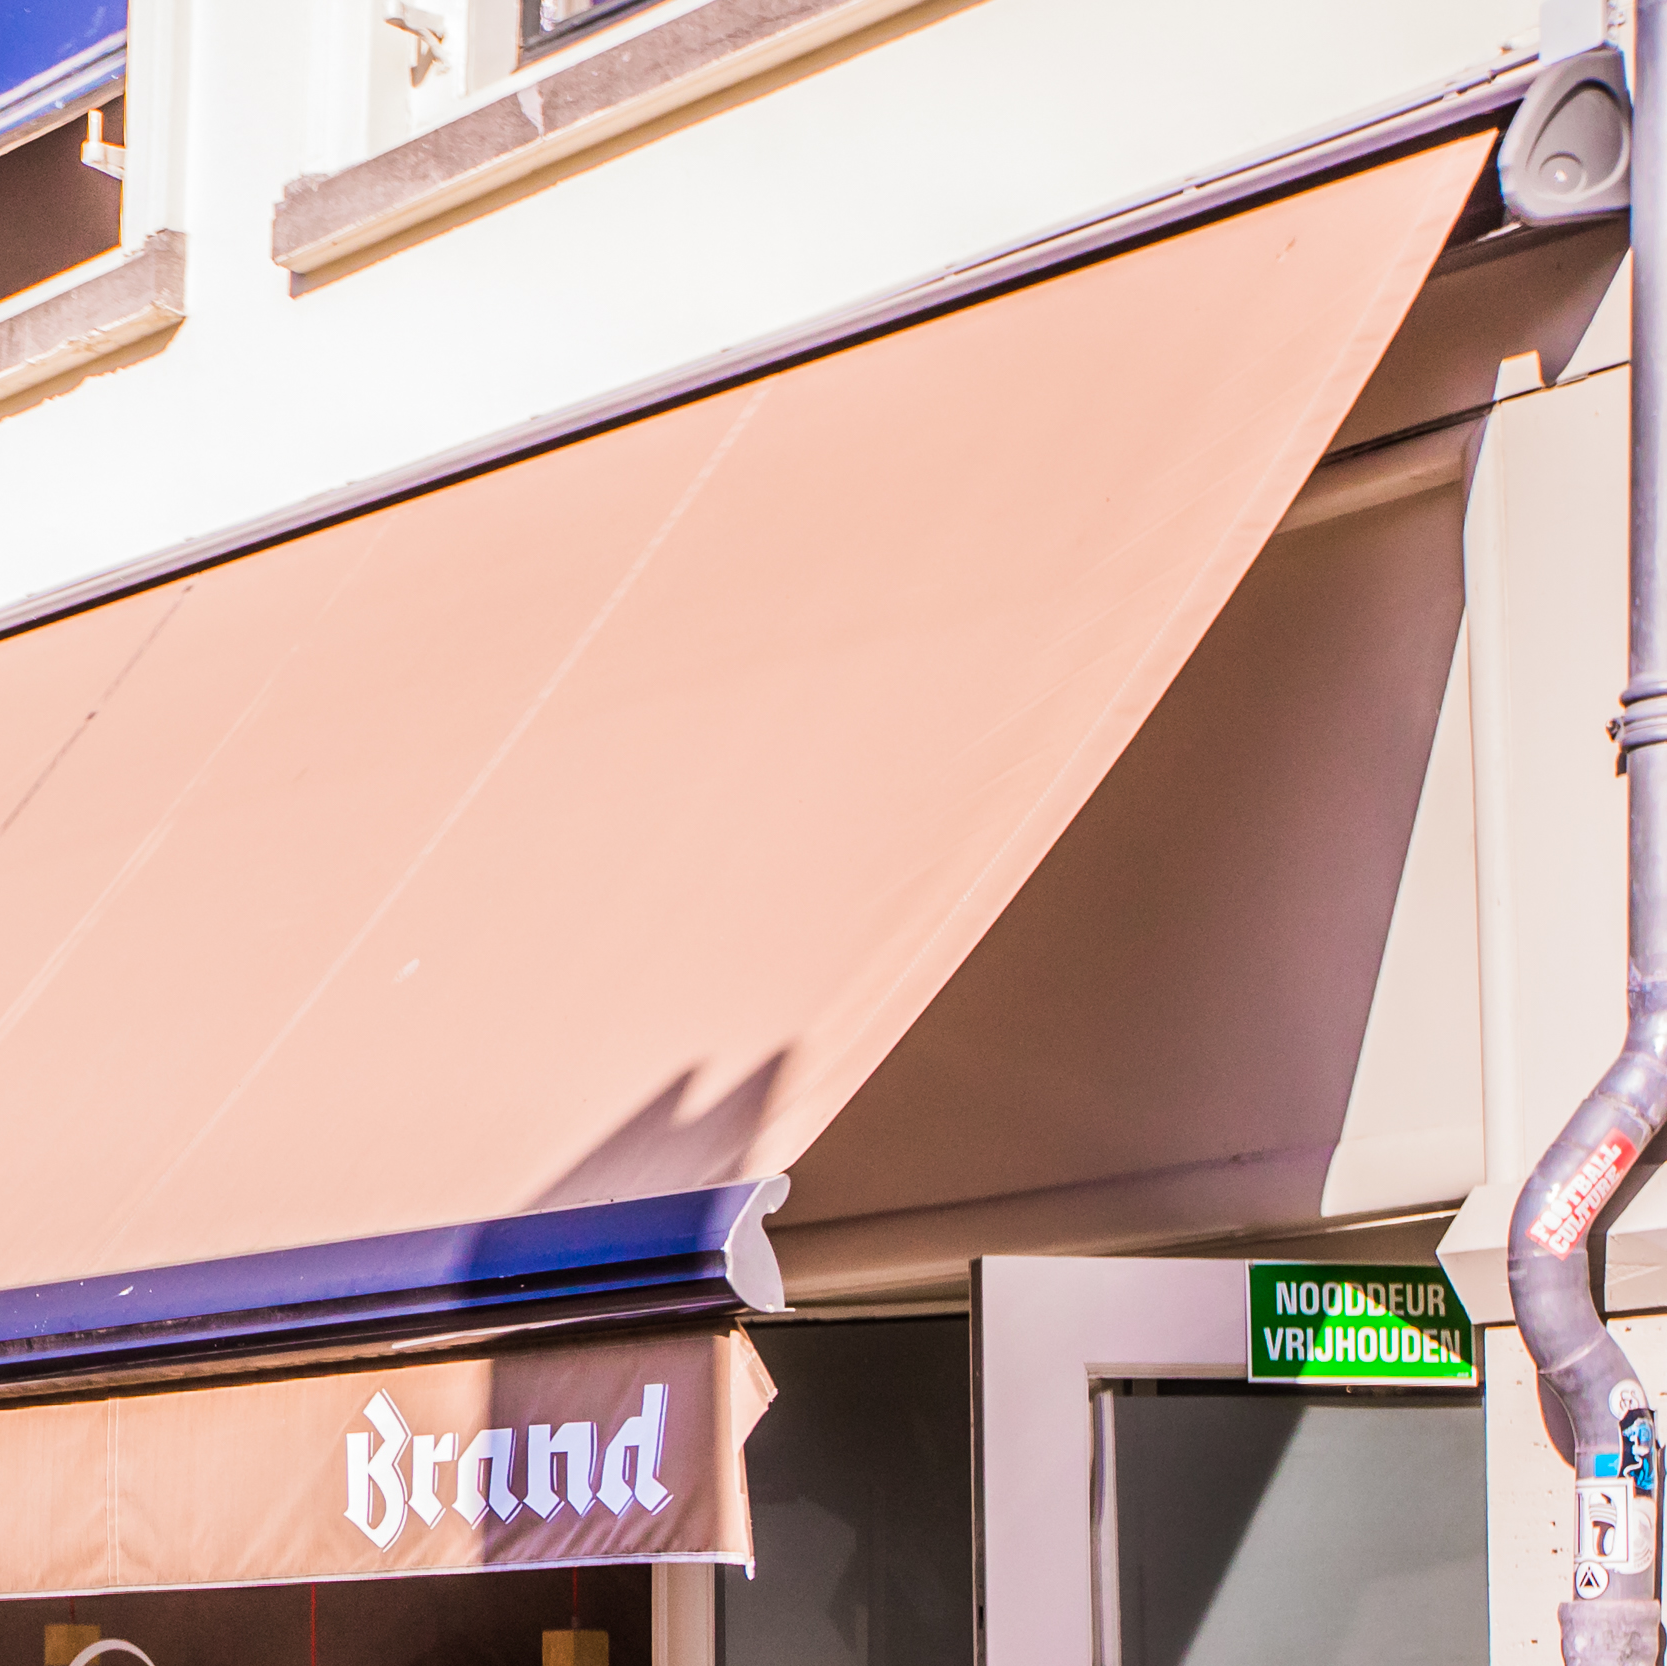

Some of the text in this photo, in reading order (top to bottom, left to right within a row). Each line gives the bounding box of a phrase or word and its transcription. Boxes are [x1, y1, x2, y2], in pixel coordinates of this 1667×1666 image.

[1530, 1143, 1622, 1243] FOOTBALL
[1548, 1164, 1621, 1253] CULTURE
[1275, 1281, 1446, 1317] NOODDEUR
[1263, 1325, 1462, 1364] VRIJHOUDEN
[343, 1383, 674, 1553] Brand
